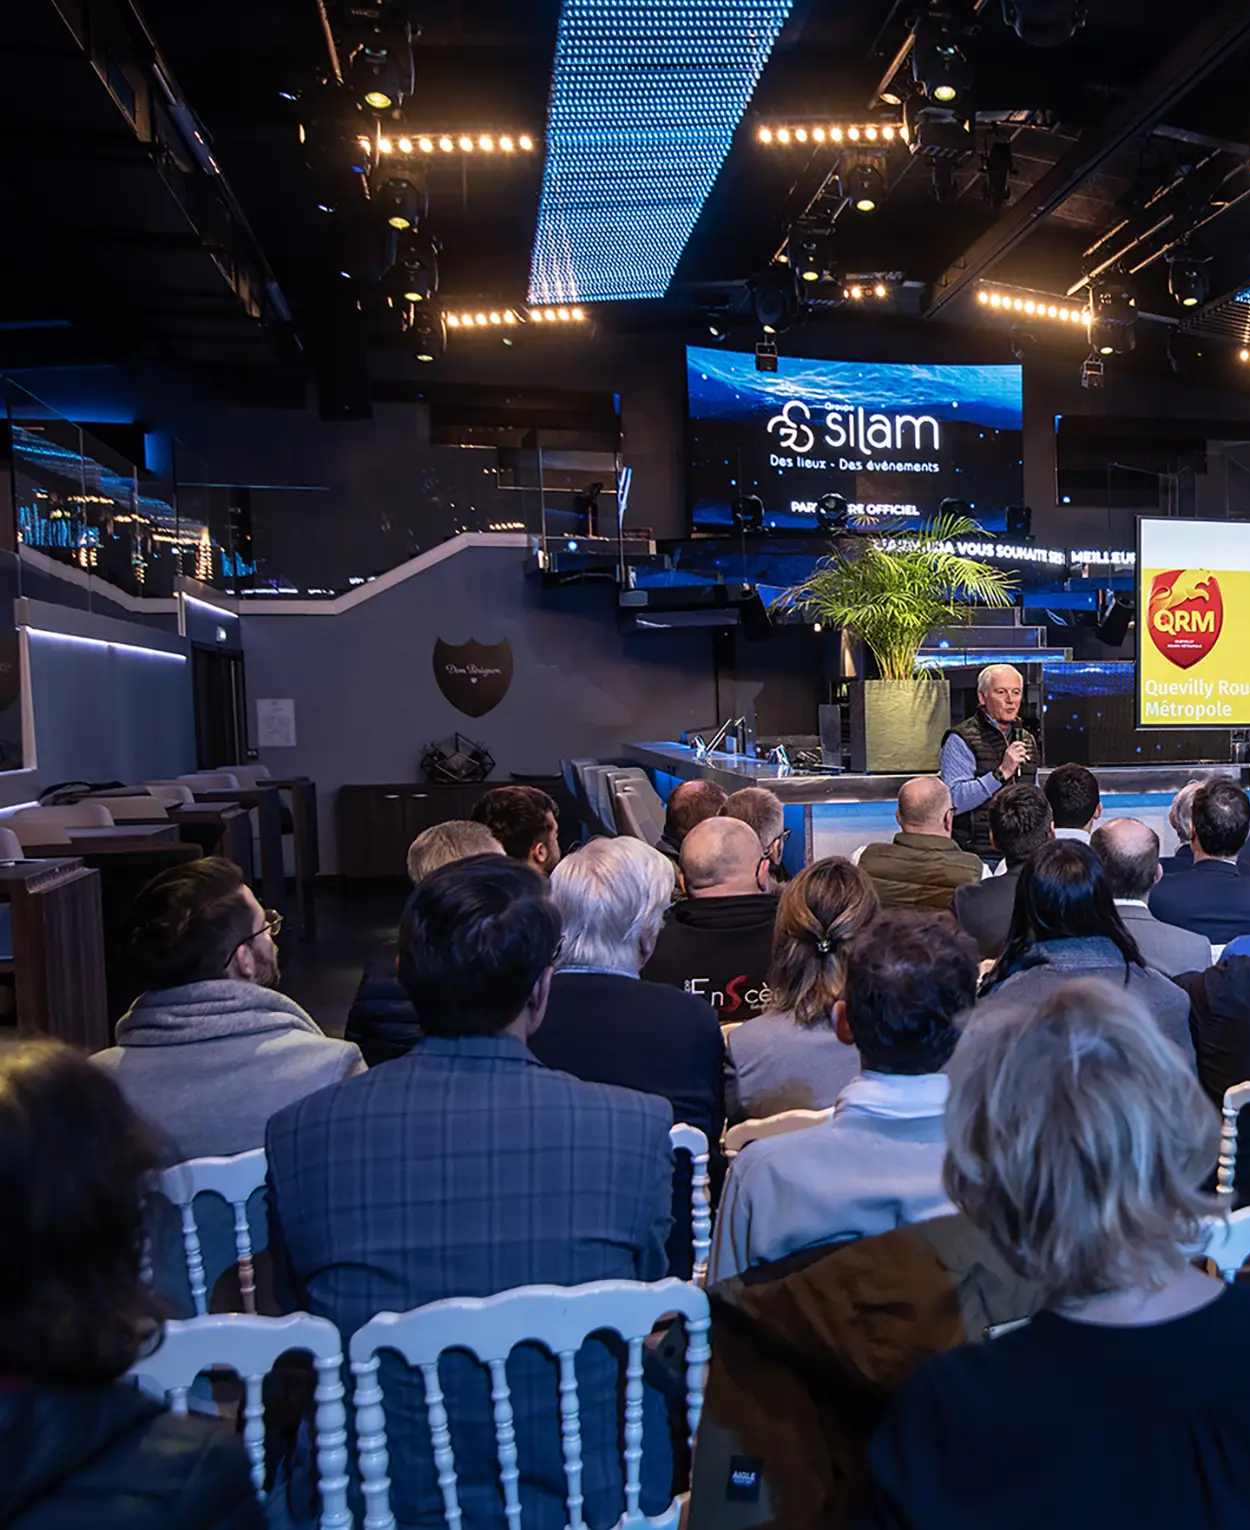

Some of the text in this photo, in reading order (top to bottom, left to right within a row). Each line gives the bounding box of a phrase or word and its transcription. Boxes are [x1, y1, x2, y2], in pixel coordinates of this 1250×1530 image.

[825, 406, 939, 455] silam
[770, 454, 793, 467] Des
[797, 456, 827, 469] lieux
[839, 458, 862, 470] Des
[866, 460, 940, 473] événements
[791, 501, 920, 516] PARRE OFFICIEL
[957, 541, 994, 557] VOUS
[995, 544, 1047, 563] SOUHAITE
[1153, 609, 1215, 636] QRM
[1144, 677, 1214, 699] Quevilly
[1144, 699, 1232, 720] Métropole
